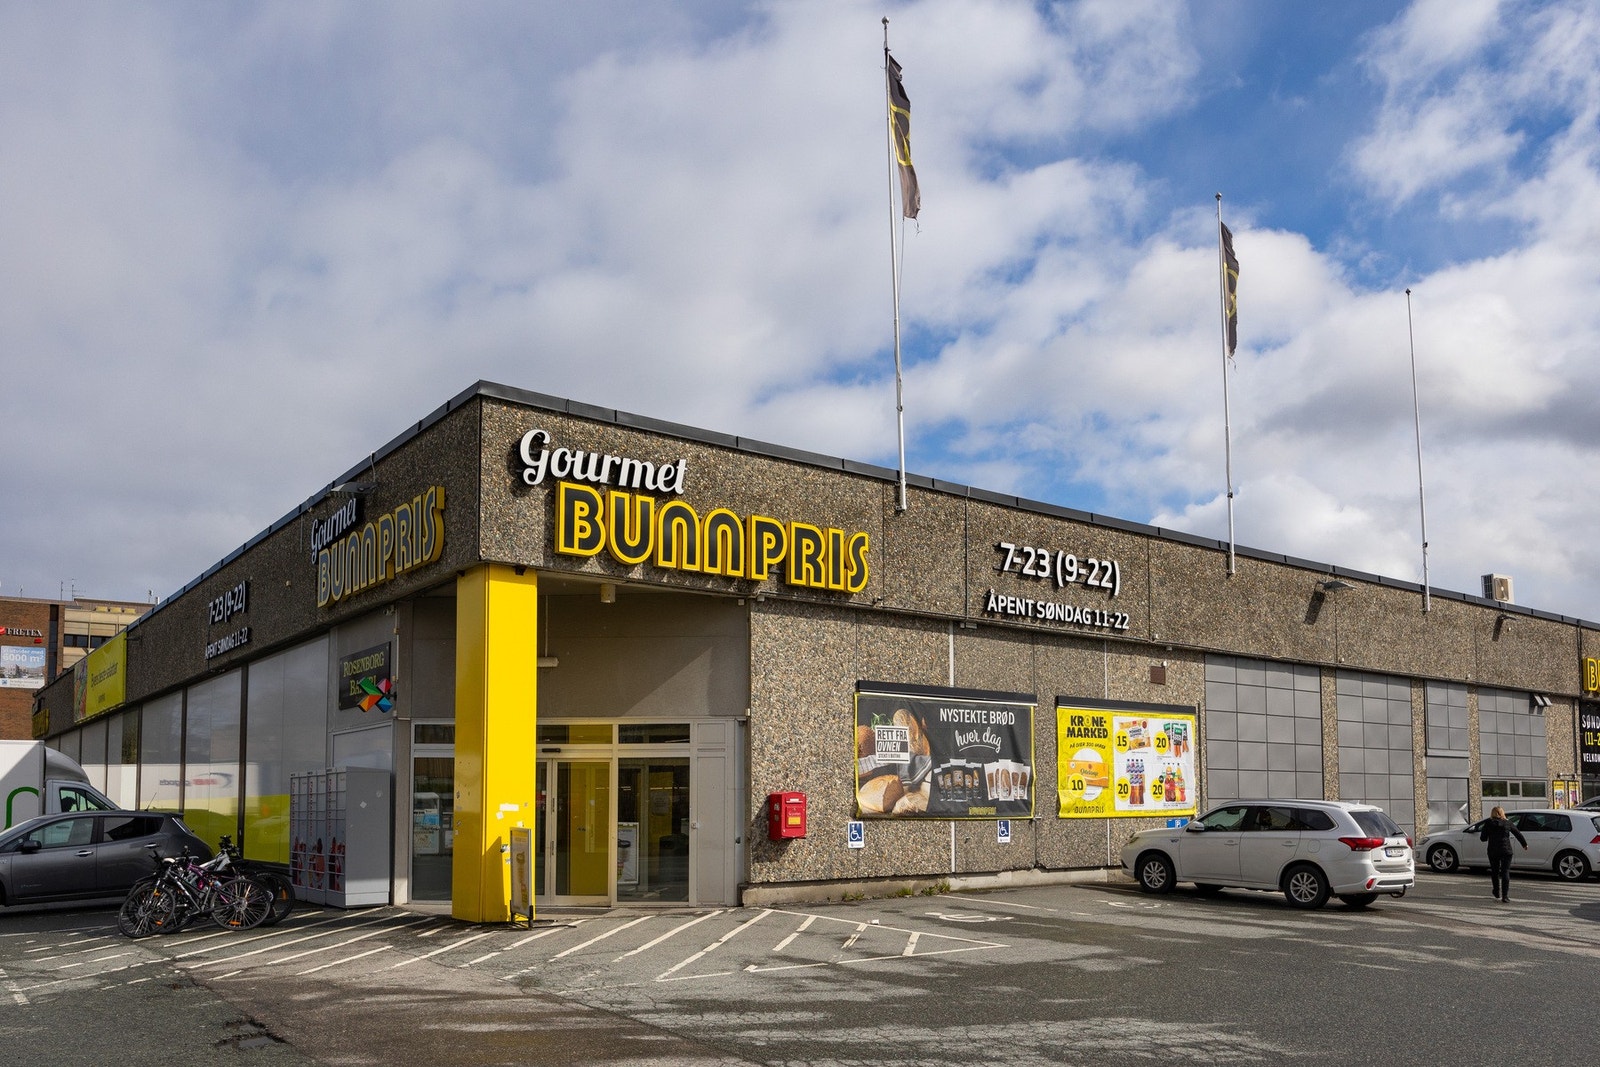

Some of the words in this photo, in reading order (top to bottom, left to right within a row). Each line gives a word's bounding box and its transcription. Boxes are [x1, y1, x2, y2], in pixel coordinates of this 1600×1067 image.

[519, 428, 689, 495] Gourmet
[554, 480, 870, 594] BUNNPRIS
[317, 485, 444, 608] BUNNPRIS
[1000, 541, 1051, 578] 7-23
[1056, 550, 1121, 597] (9-22)
[208, 596, 223, 625] 7-23
[224, 580, 246, 623] (9-22)
[987, 588, 1034, 617] ÅPENT
[1036, 601, 1092, 625] SØNDAG
[1094, 610, 1130, 630] 11-22
[343, 651, 385, 677] ROSENBORG
[939, 708, 987, 724] NYSTEKTE
[989, 710, 1016, 726] BRØD
[877, 729, 894, 740] RETT
[895, 730, 908, 741] FRA
[954, 728, 982, 747] hver
[981, 726, 1003, 753] dag
[1066, 726, 1109, 739] MARKED
[1116, 735, 1128, 747] 15
[877, 741, 901, 752] OVNEN
[1156, 737, 1167, 748] 20
[1071, 779, 1084, 791] 10
[1117, 783, 1129, 795] 20
[1152, 784, 1163, 795] 20
